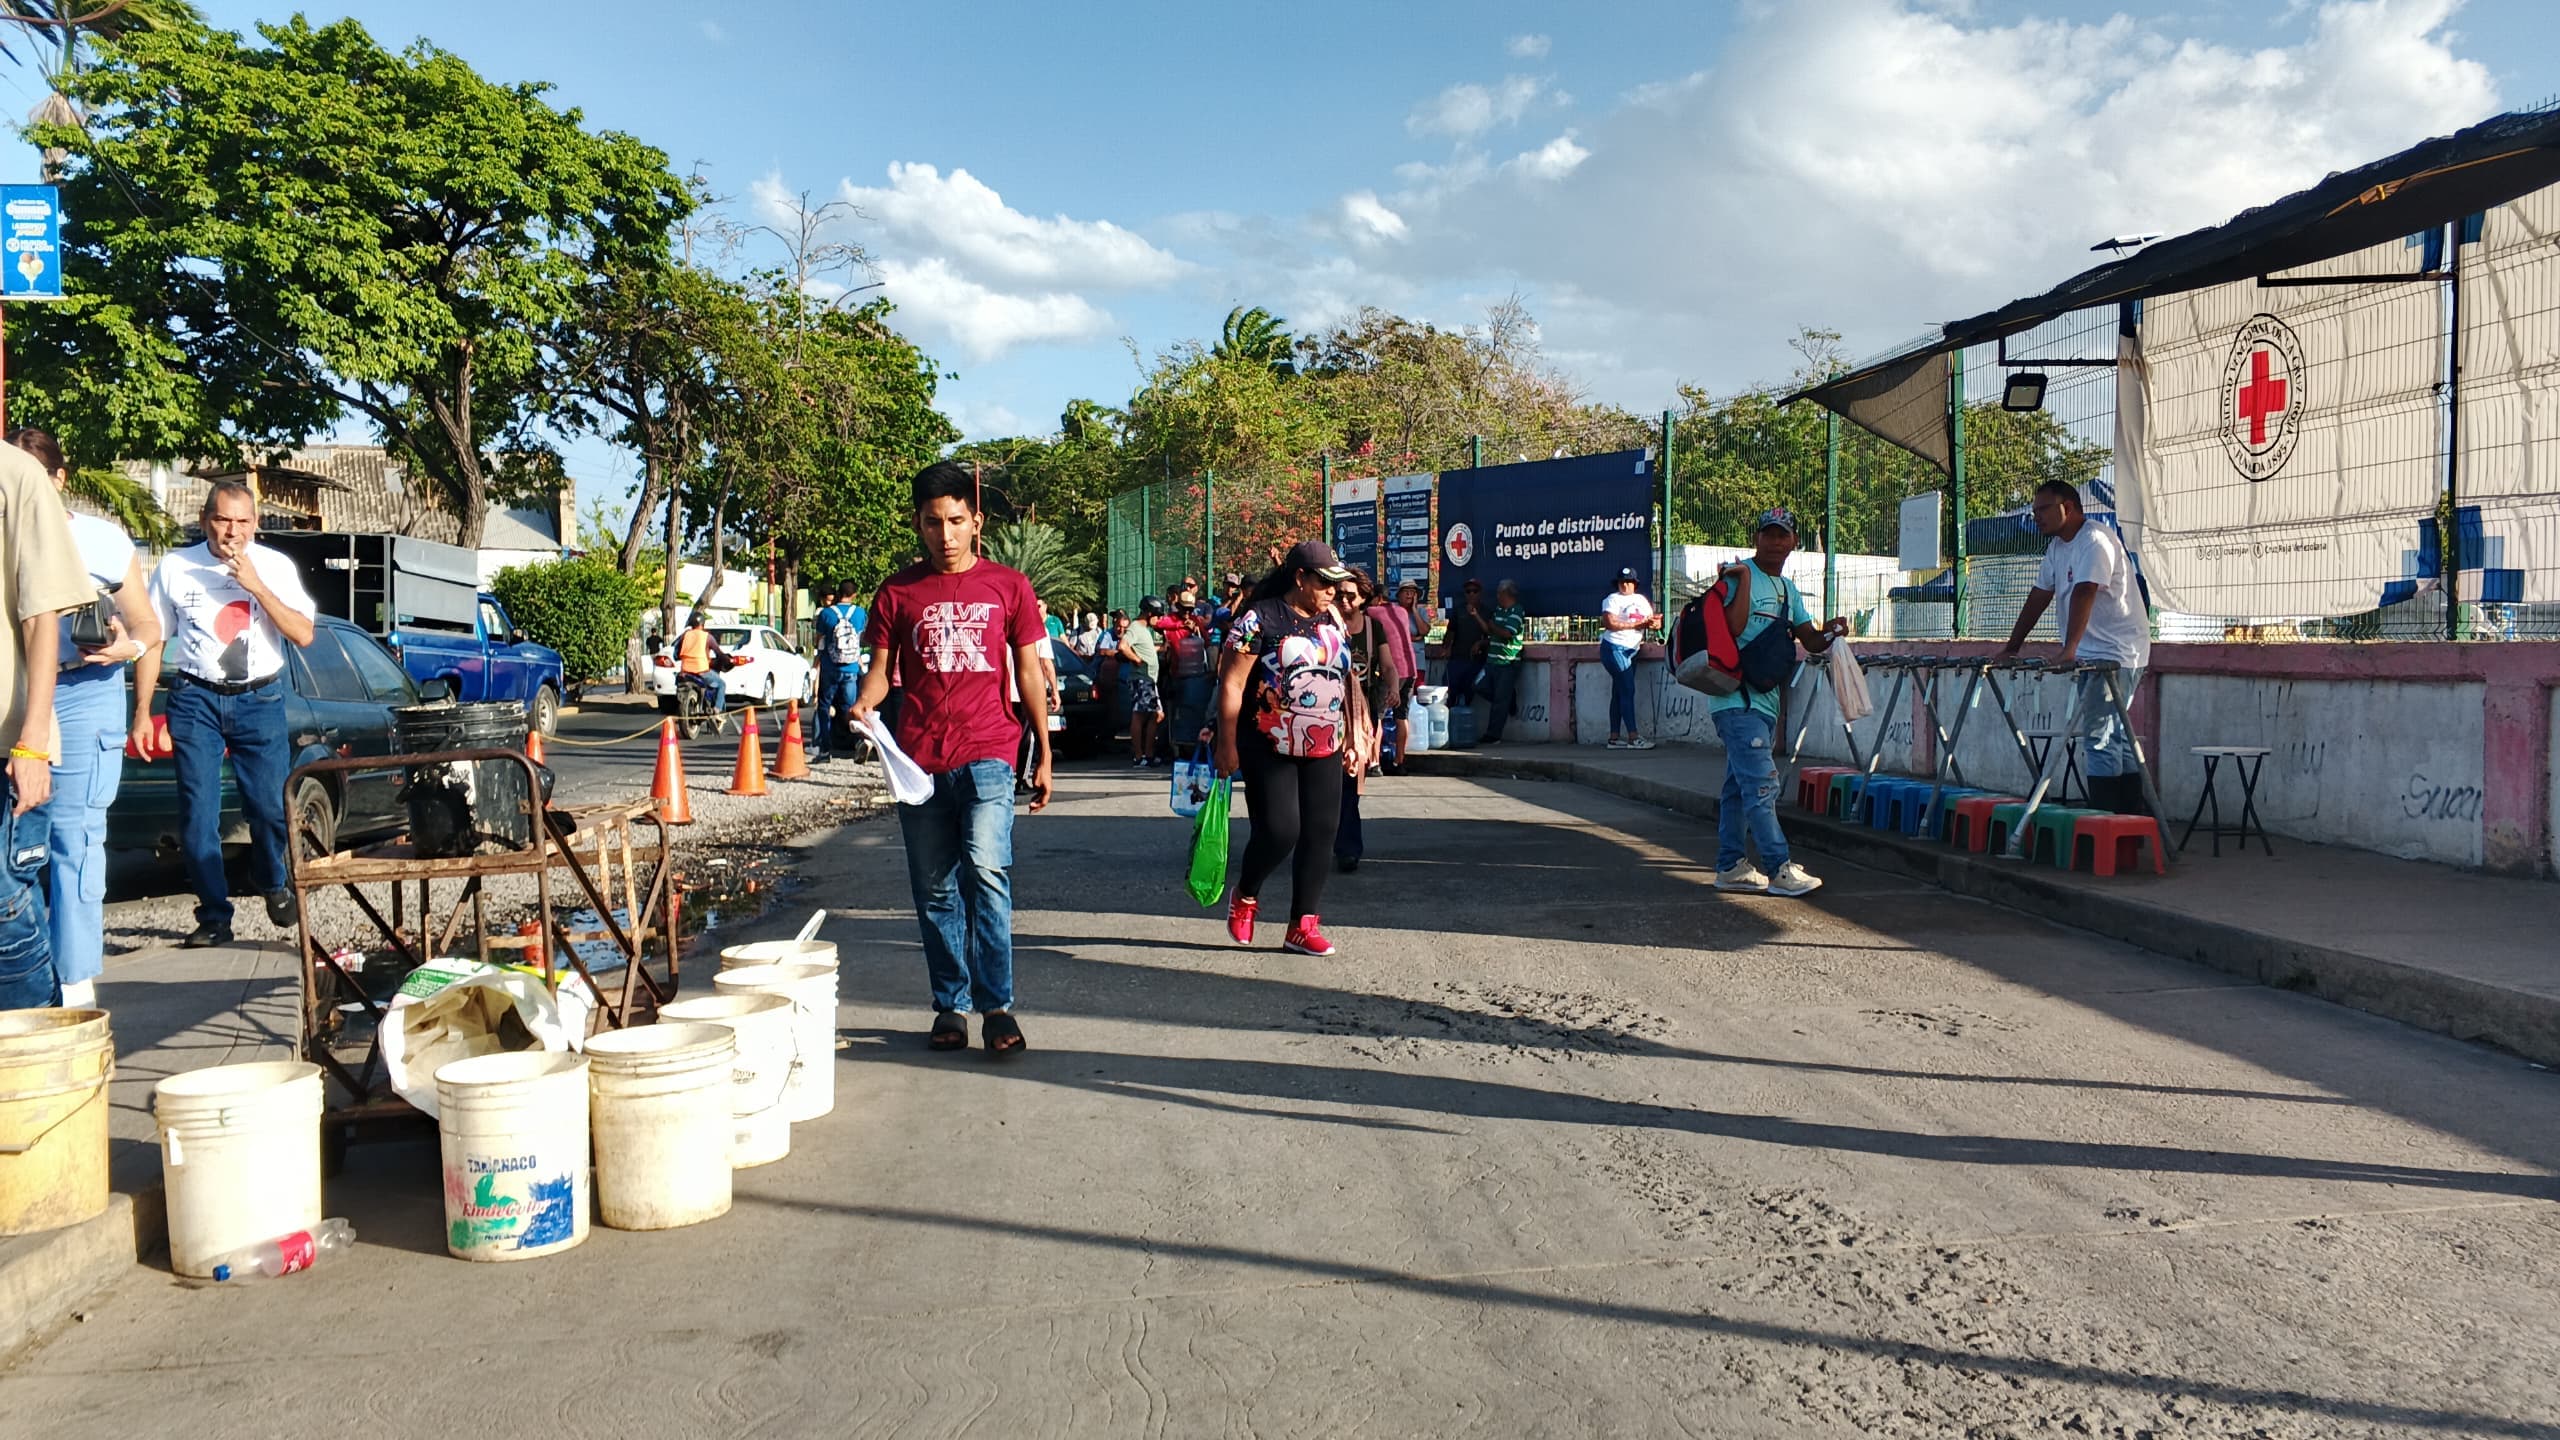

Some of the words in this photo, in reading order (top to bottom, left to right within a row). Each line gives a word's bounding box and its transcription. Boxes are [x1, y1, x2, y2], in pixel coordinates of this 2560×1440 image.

[1496, 523, 1535, 539] Punto
[1538, 520, 1555, 536] de
[1557, 512, 1645, 534] distribución
[1496, 542, 1512, 557] de
[1515, 542, 1547, 560] agua
[1551, 536, 1604, 559] potable
[922, 604, 990, 622] CALVIN
[928, 628, 982, 646] KLEIN
